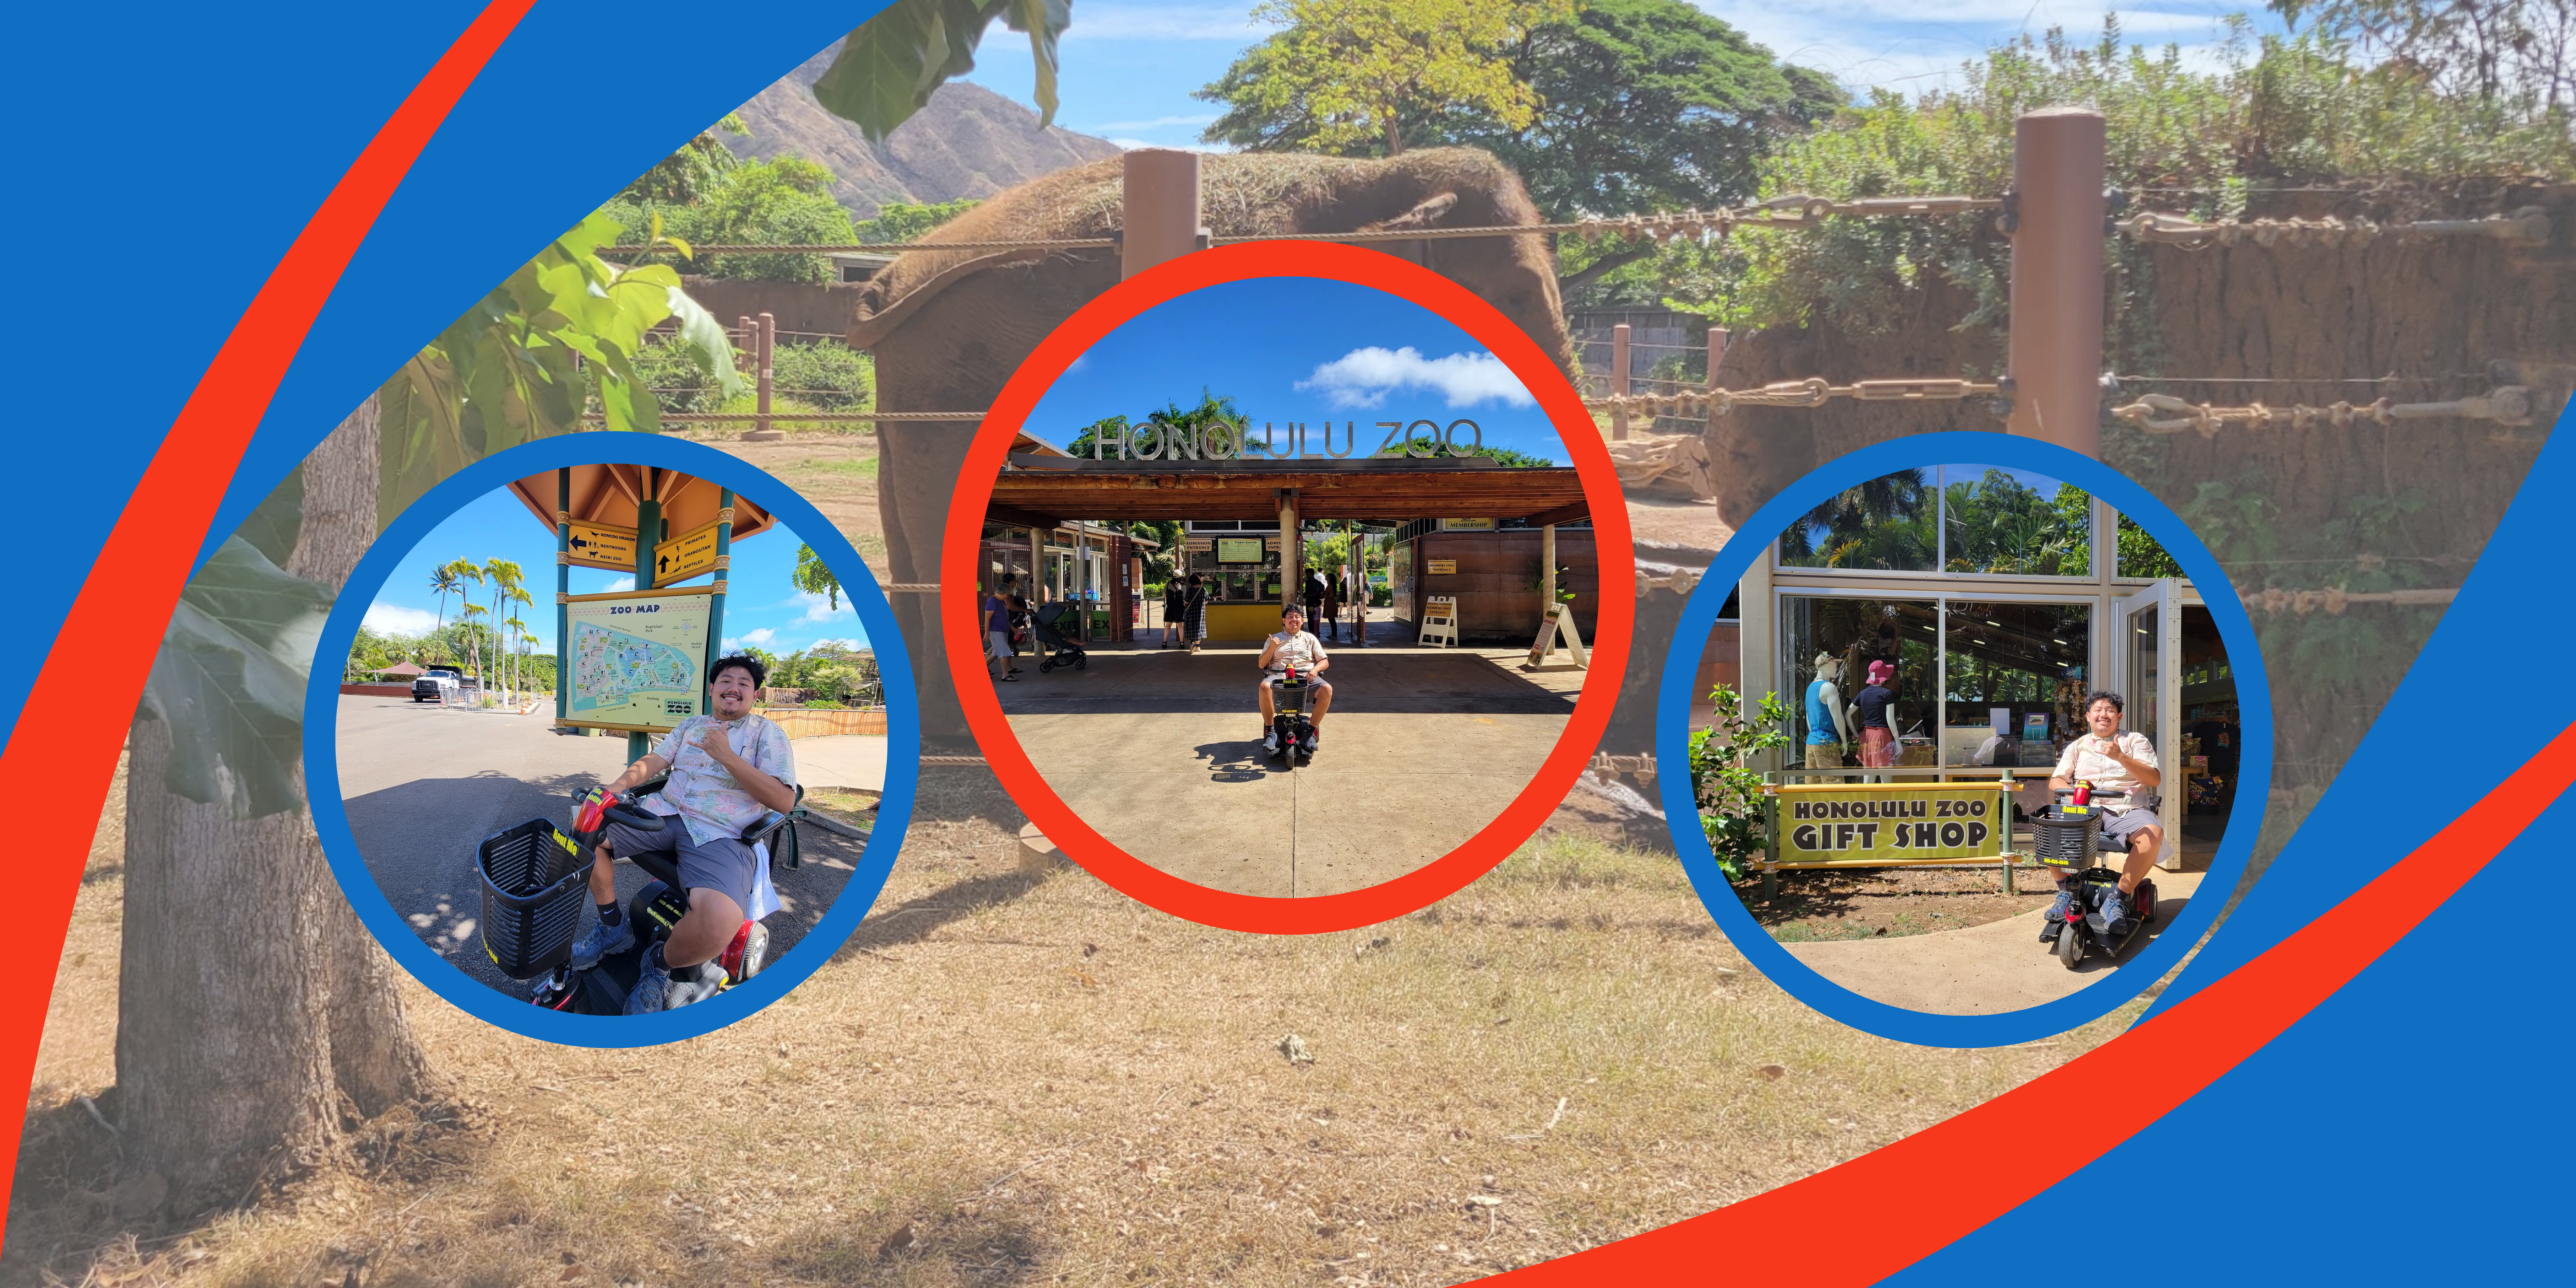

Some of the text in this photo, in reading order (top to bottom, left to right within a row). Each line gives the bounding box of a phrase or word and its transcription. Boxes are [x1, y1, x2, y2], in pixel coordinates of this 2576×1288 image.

[1095, 419, 1482, 461] HONOLULU ZOO
[685, 534, 706, 546] PRIMATES
[684, 544, 711, 558] ORANGUTAN
[684, 559, 703, 569] REPTILES
[610, 604, 660, 615] ZOO MAP
[667, 705, 691, 714] ZOO
[2188, 784, 2203, 794] SPAM
[1794, 799, 1987, 820] HONOLULU ZOO
[553, 828, 577, 856] Rent Me
[1791, 820, 1989, 851] GIFT SHOP
[658, 899, 683, 918] 855-456-4846
